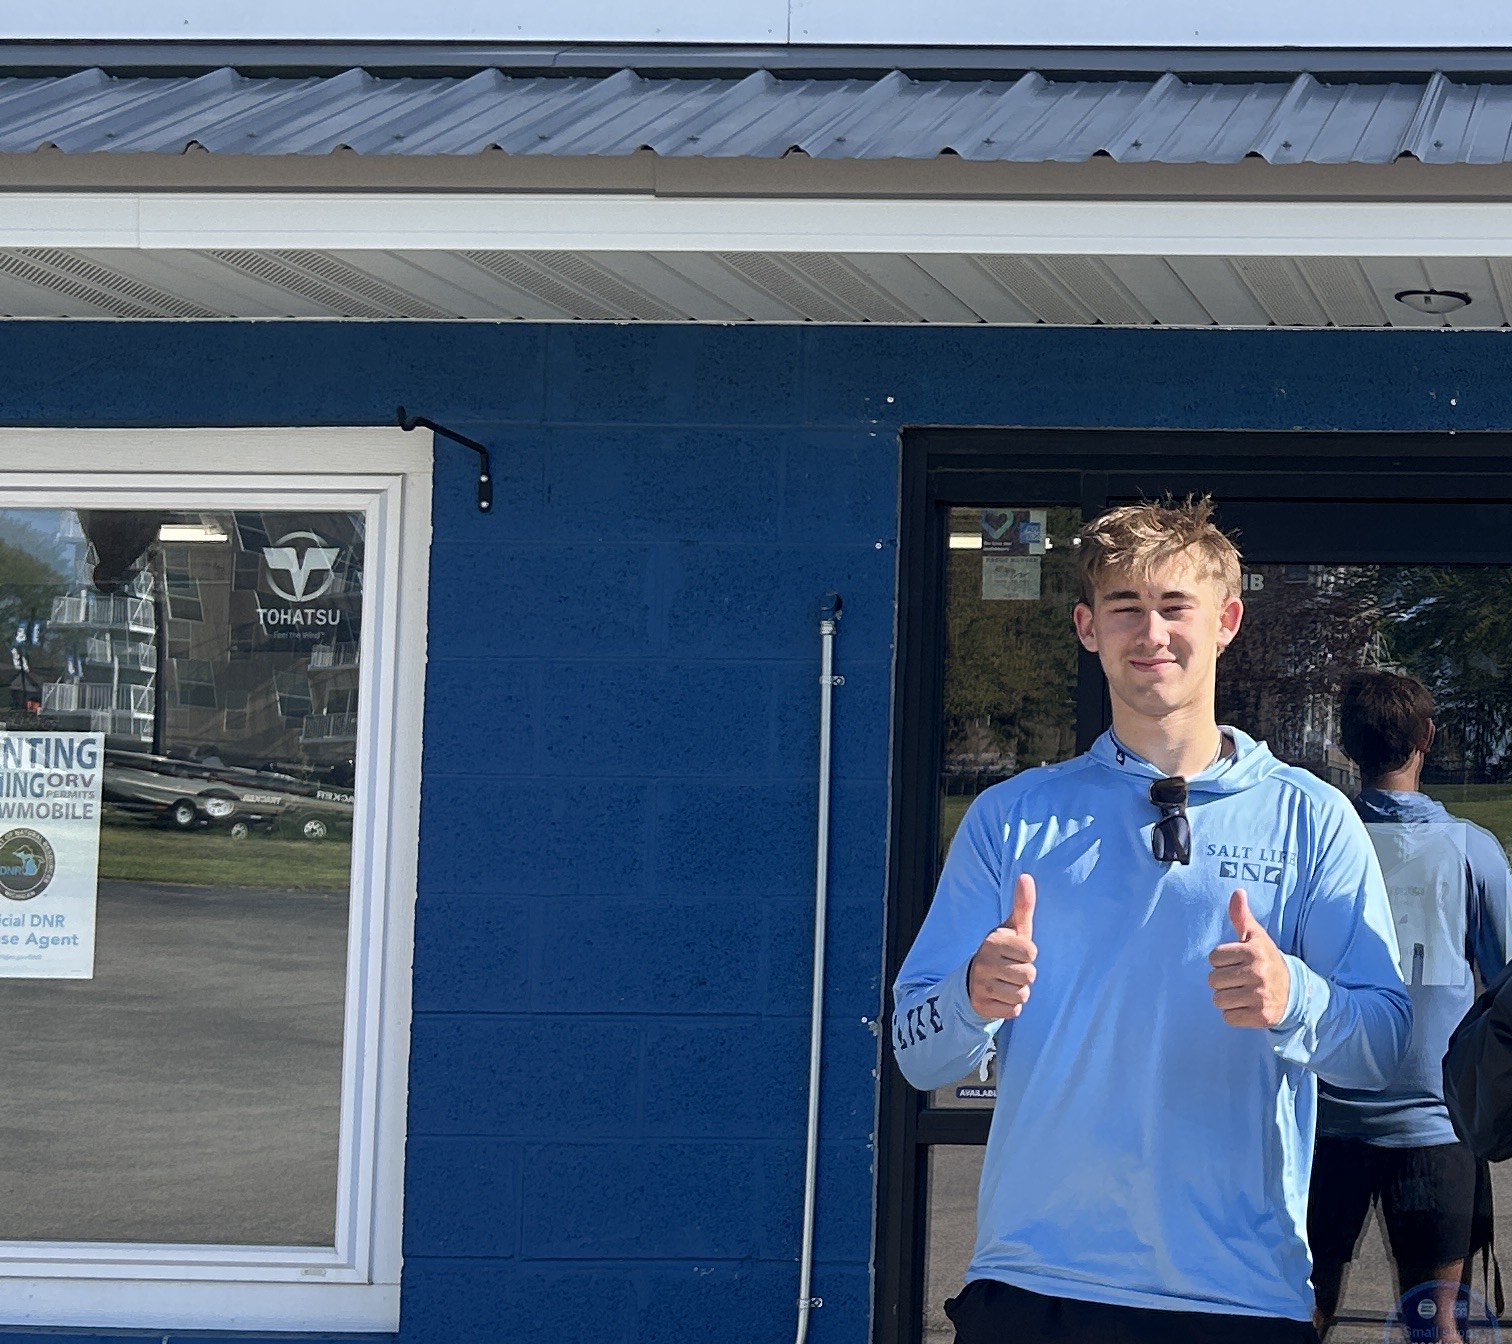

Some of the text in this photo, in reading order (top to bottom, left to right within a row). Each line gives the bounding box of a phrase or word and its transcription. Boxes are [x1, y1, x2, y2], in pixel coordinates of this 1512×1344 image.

[256, 608, 340, 625] TOHATSU
[46, 773, 95, 787] ORV
[46, 790, 95, 799] PERMITS
[1206, 843, 1253, 859] SALT
[31, 914, 66, 928] DNR
[25, 932, 80, 949] Agent
